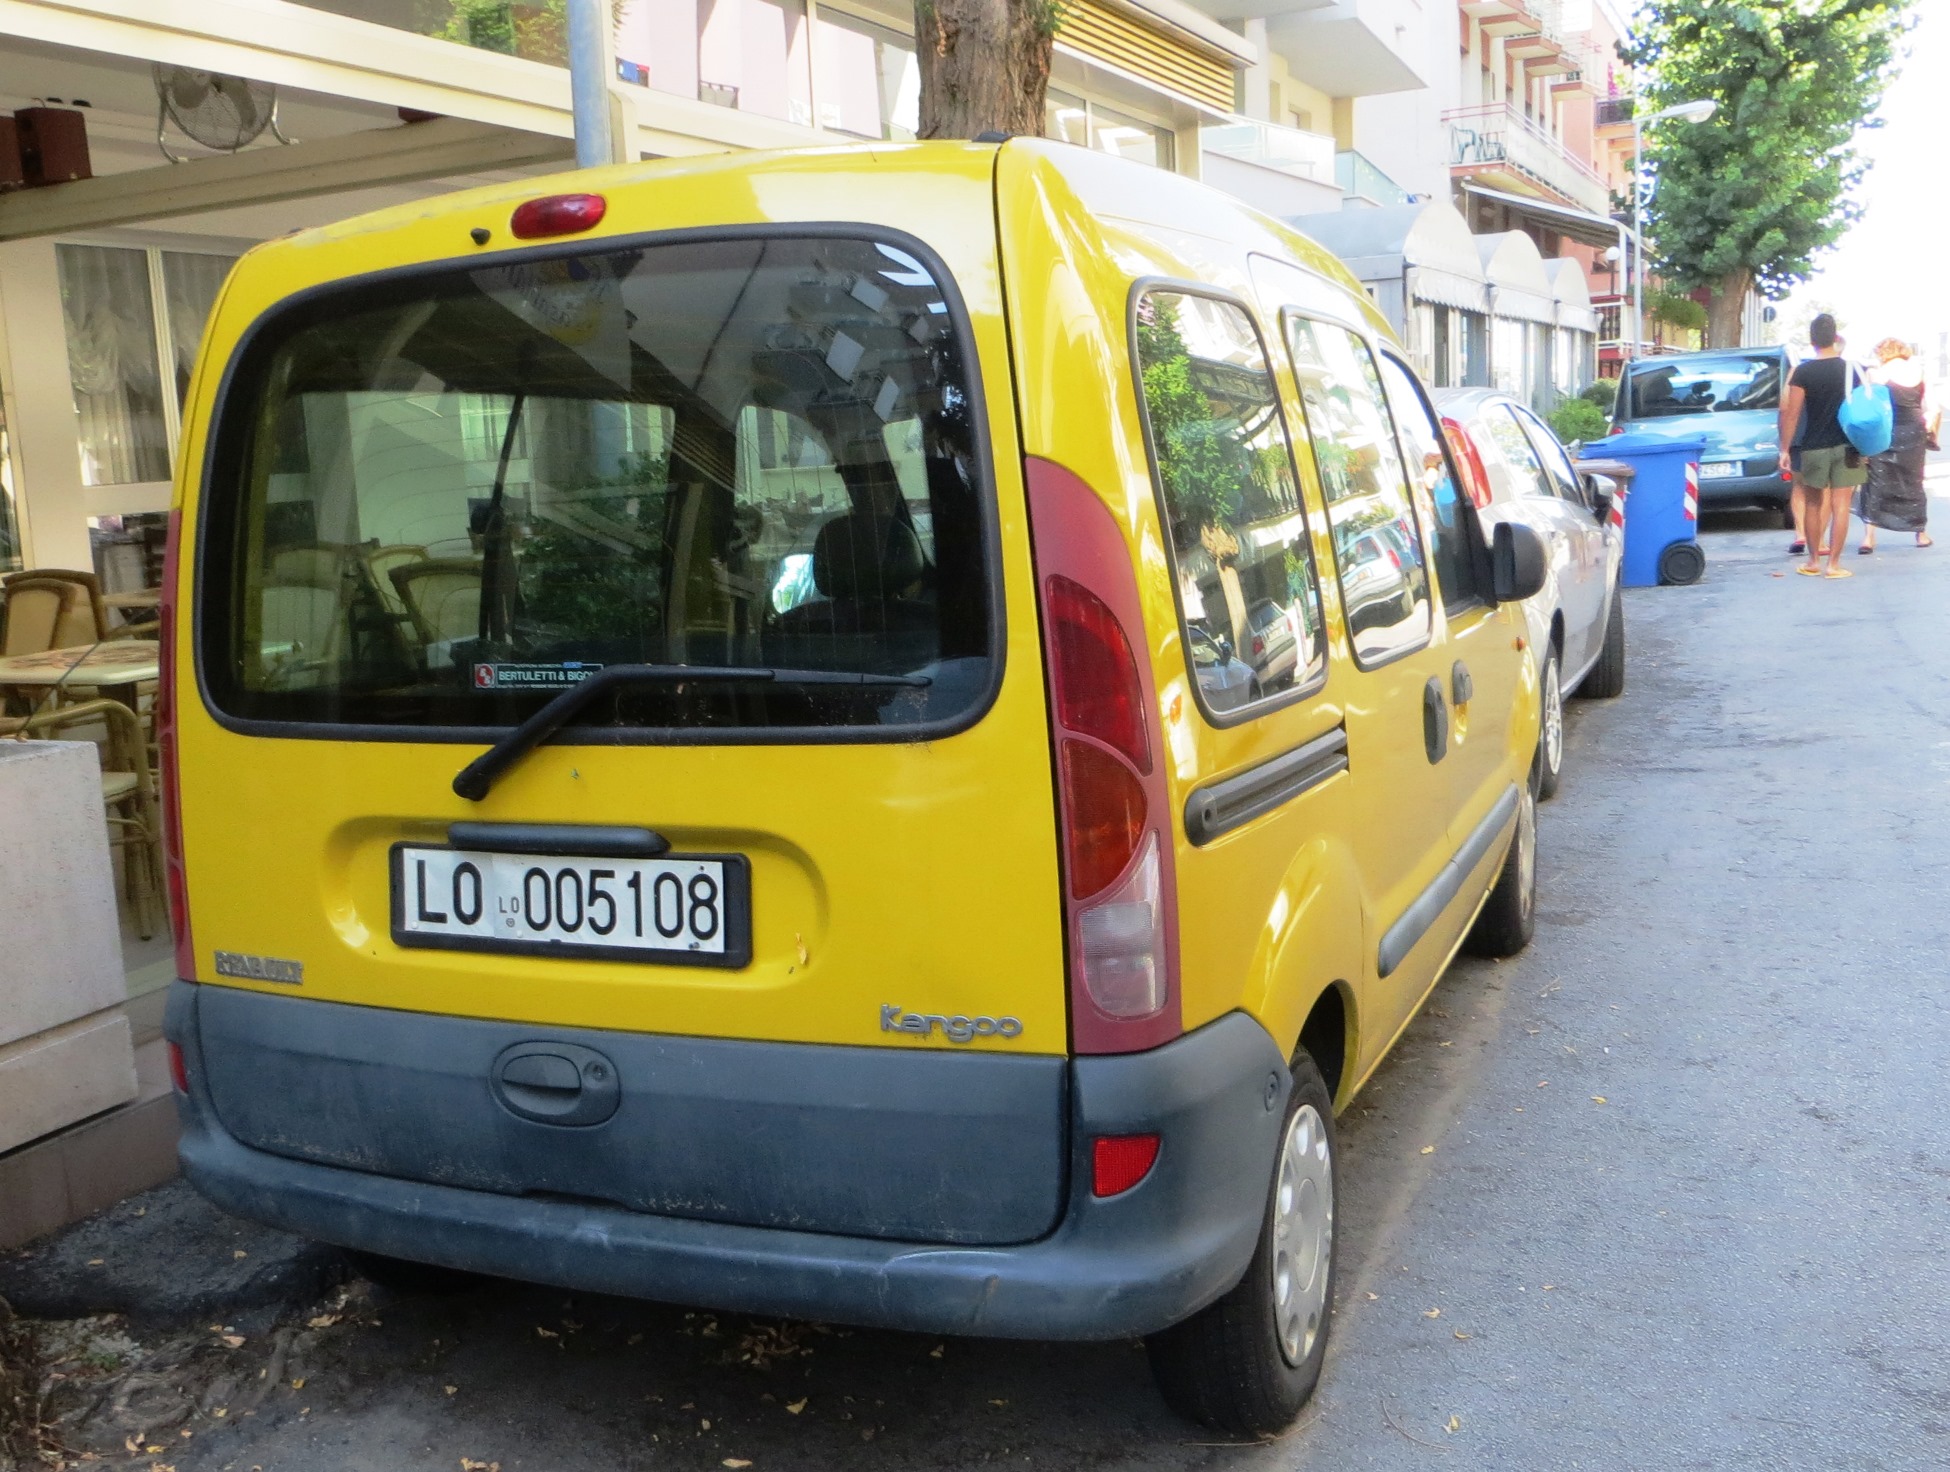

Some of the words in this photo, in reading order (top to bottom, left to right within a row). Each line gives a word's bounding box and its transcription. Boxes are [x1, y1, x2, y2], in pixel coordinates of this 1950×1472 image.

[499, 671, 557, 681] BERTULETTI
[558, 671, 565, 681] &
[523, 866, 719, 940] 005108
